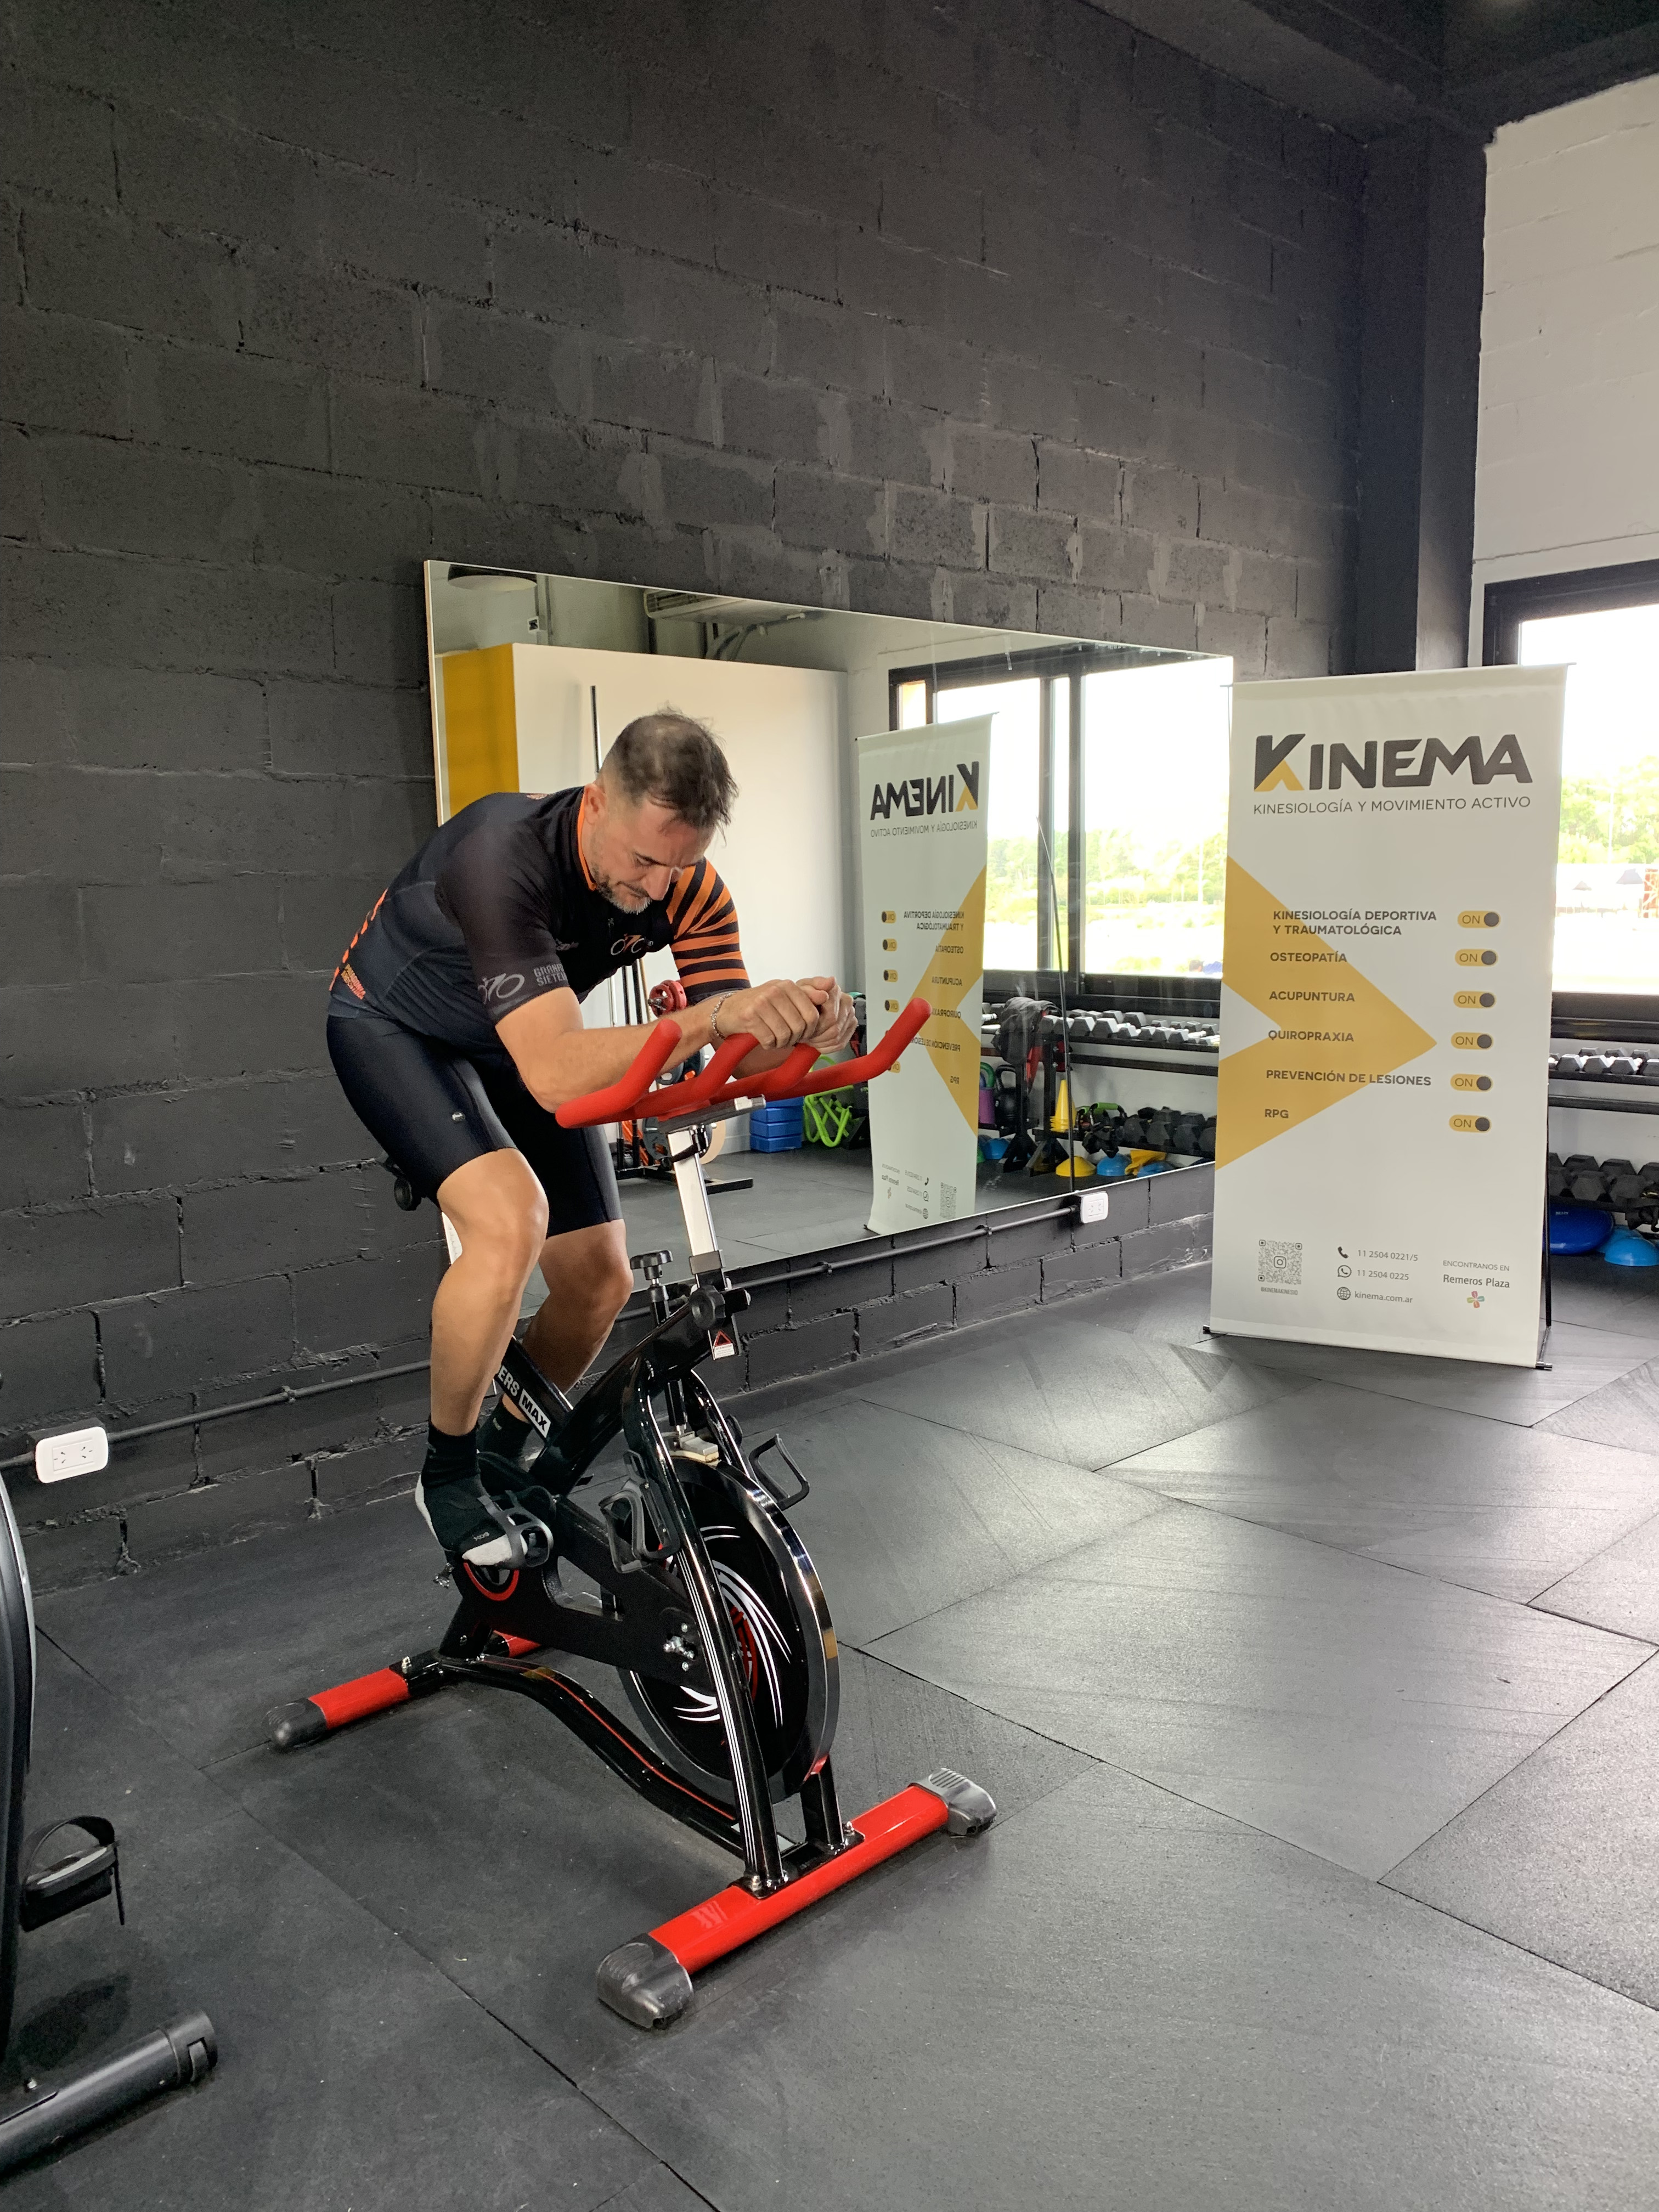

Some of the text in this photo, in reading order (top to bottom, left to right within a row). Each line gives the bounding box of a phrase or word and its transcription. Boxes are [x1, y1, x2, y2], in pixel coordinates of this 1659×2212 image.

[1254, 733, 1532, 791] KINEMA
[1254, 797, 1530, 814] KINESIOLOGÍA Y MOVIMIENTO ACTIVO
[1274, 909, 1436, 921] KINESIOLOGÍA DEPORTIVA
[1462, 915, 1480, 924] ON
[1273, 923, 1401, 935] Y TRAUMATOLÓGICA
[1270, 951, 1347, 962] OSTEOPATÍA
[1459, 953, 1478, 963] ON
[1269, 991, 1355, 1002] ACUPUNTURA
[1458, 995, 1476, 1005] ON
[1268, 1030, 1353, 1042] QUIROPRAXIA
[1455, 1036, 1474, 1045] ON
[1267, 1070, 1431, 1086] PREVENCIÓN DE LESIONES
[1455, 1078, 1473, 1087] ON
[1265, 1109, 1289, 1119] RPG
[1453, 1119, 1472, 1128] ON
[1390, 1252, 1418, 1261] 0221/5
[1443, 1260, 1498, 1270] ENCONTRANOS
[1443, 1274, 1509, 1288] Remeros Plaza
[1355, 1291, 1413, 1303] kinema.com.ar
[498, 1365, 547, 1432] ERS MAX
